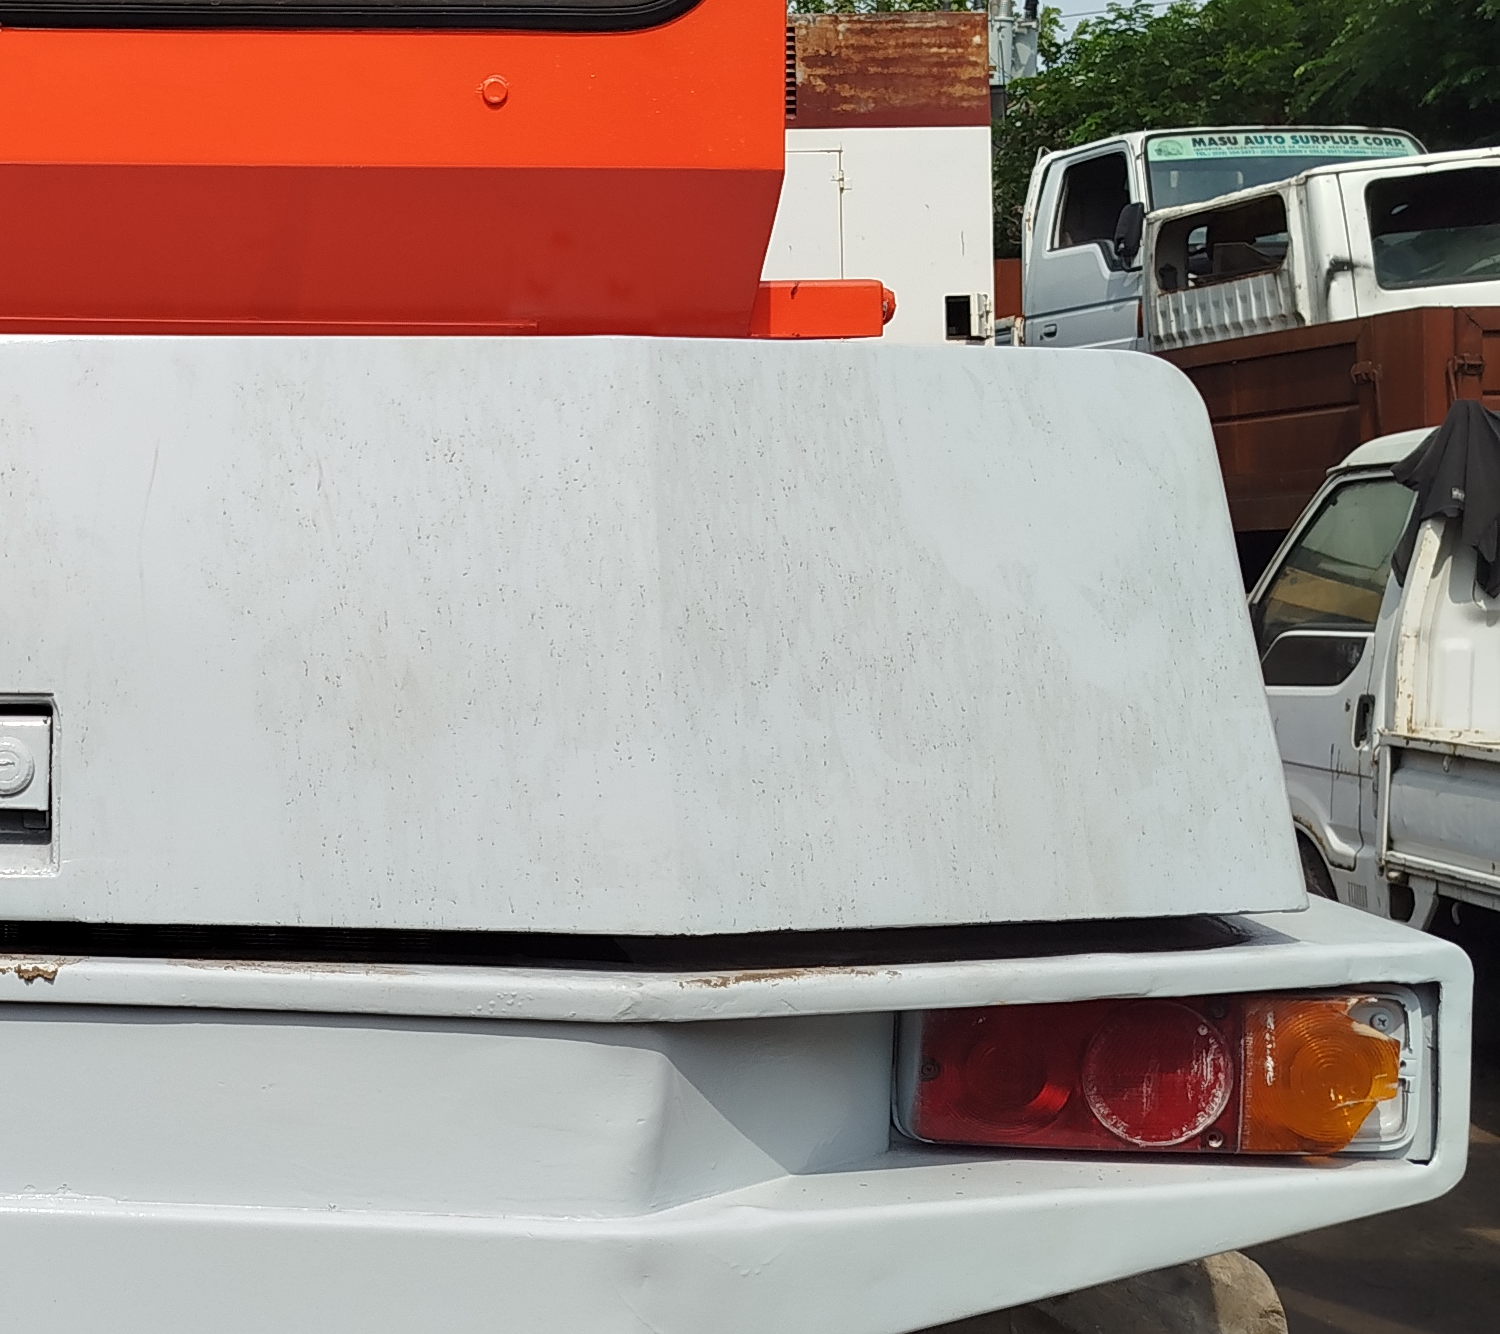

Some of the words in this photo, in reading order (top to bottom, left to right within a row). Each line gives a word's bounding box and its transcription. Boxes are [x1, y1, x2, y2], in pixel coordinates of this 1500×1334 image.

[1191, 135, 1238, 147] MASU
[1246, 135, 1286, 146] AUTO
[1289, 134, 1359, 146] SURPLUS
[1362, 135, 1406, 148] CORP.
